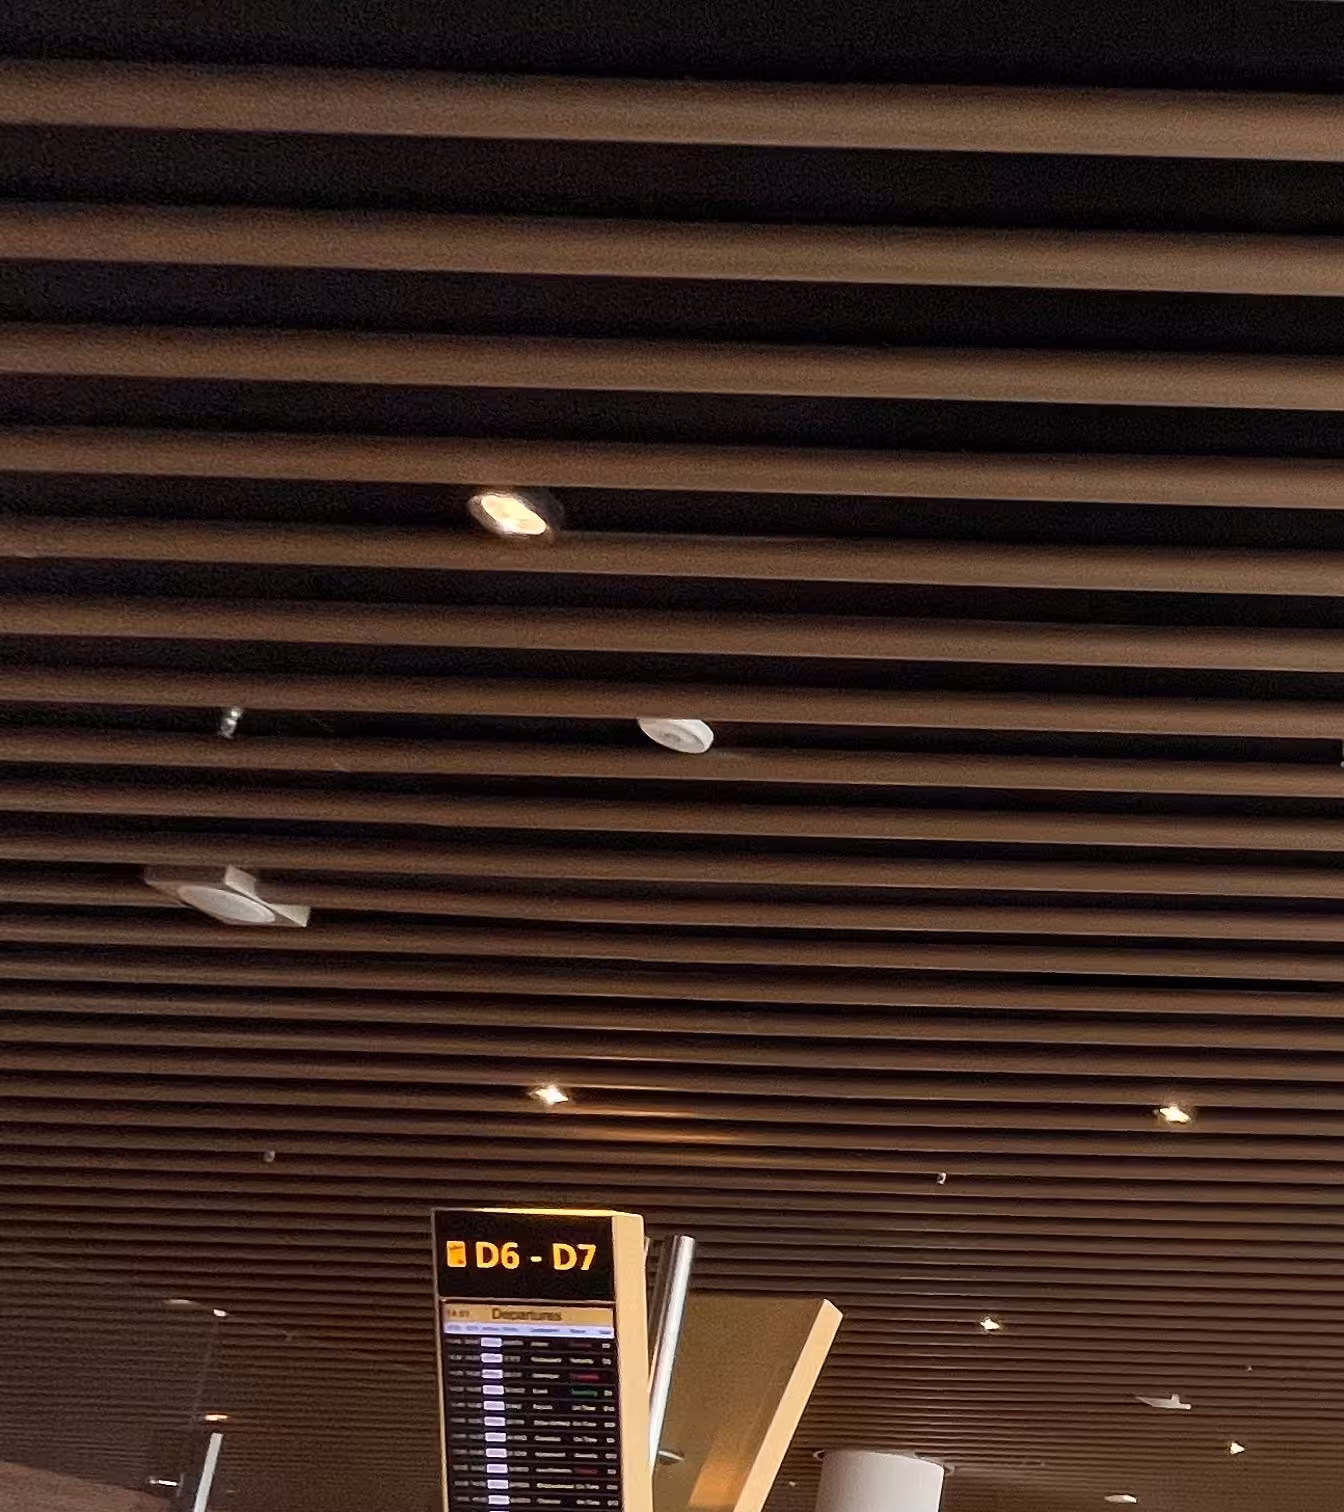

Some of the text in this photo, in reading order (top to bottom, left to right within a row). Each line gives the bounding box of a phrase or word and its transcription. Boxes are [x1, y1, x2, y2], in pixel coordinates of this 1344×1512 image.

[475, 1241, 520, 1269] D6
[552, 1243, 596, 1271] D7
[491, 1308, 562, 1321] Departures
